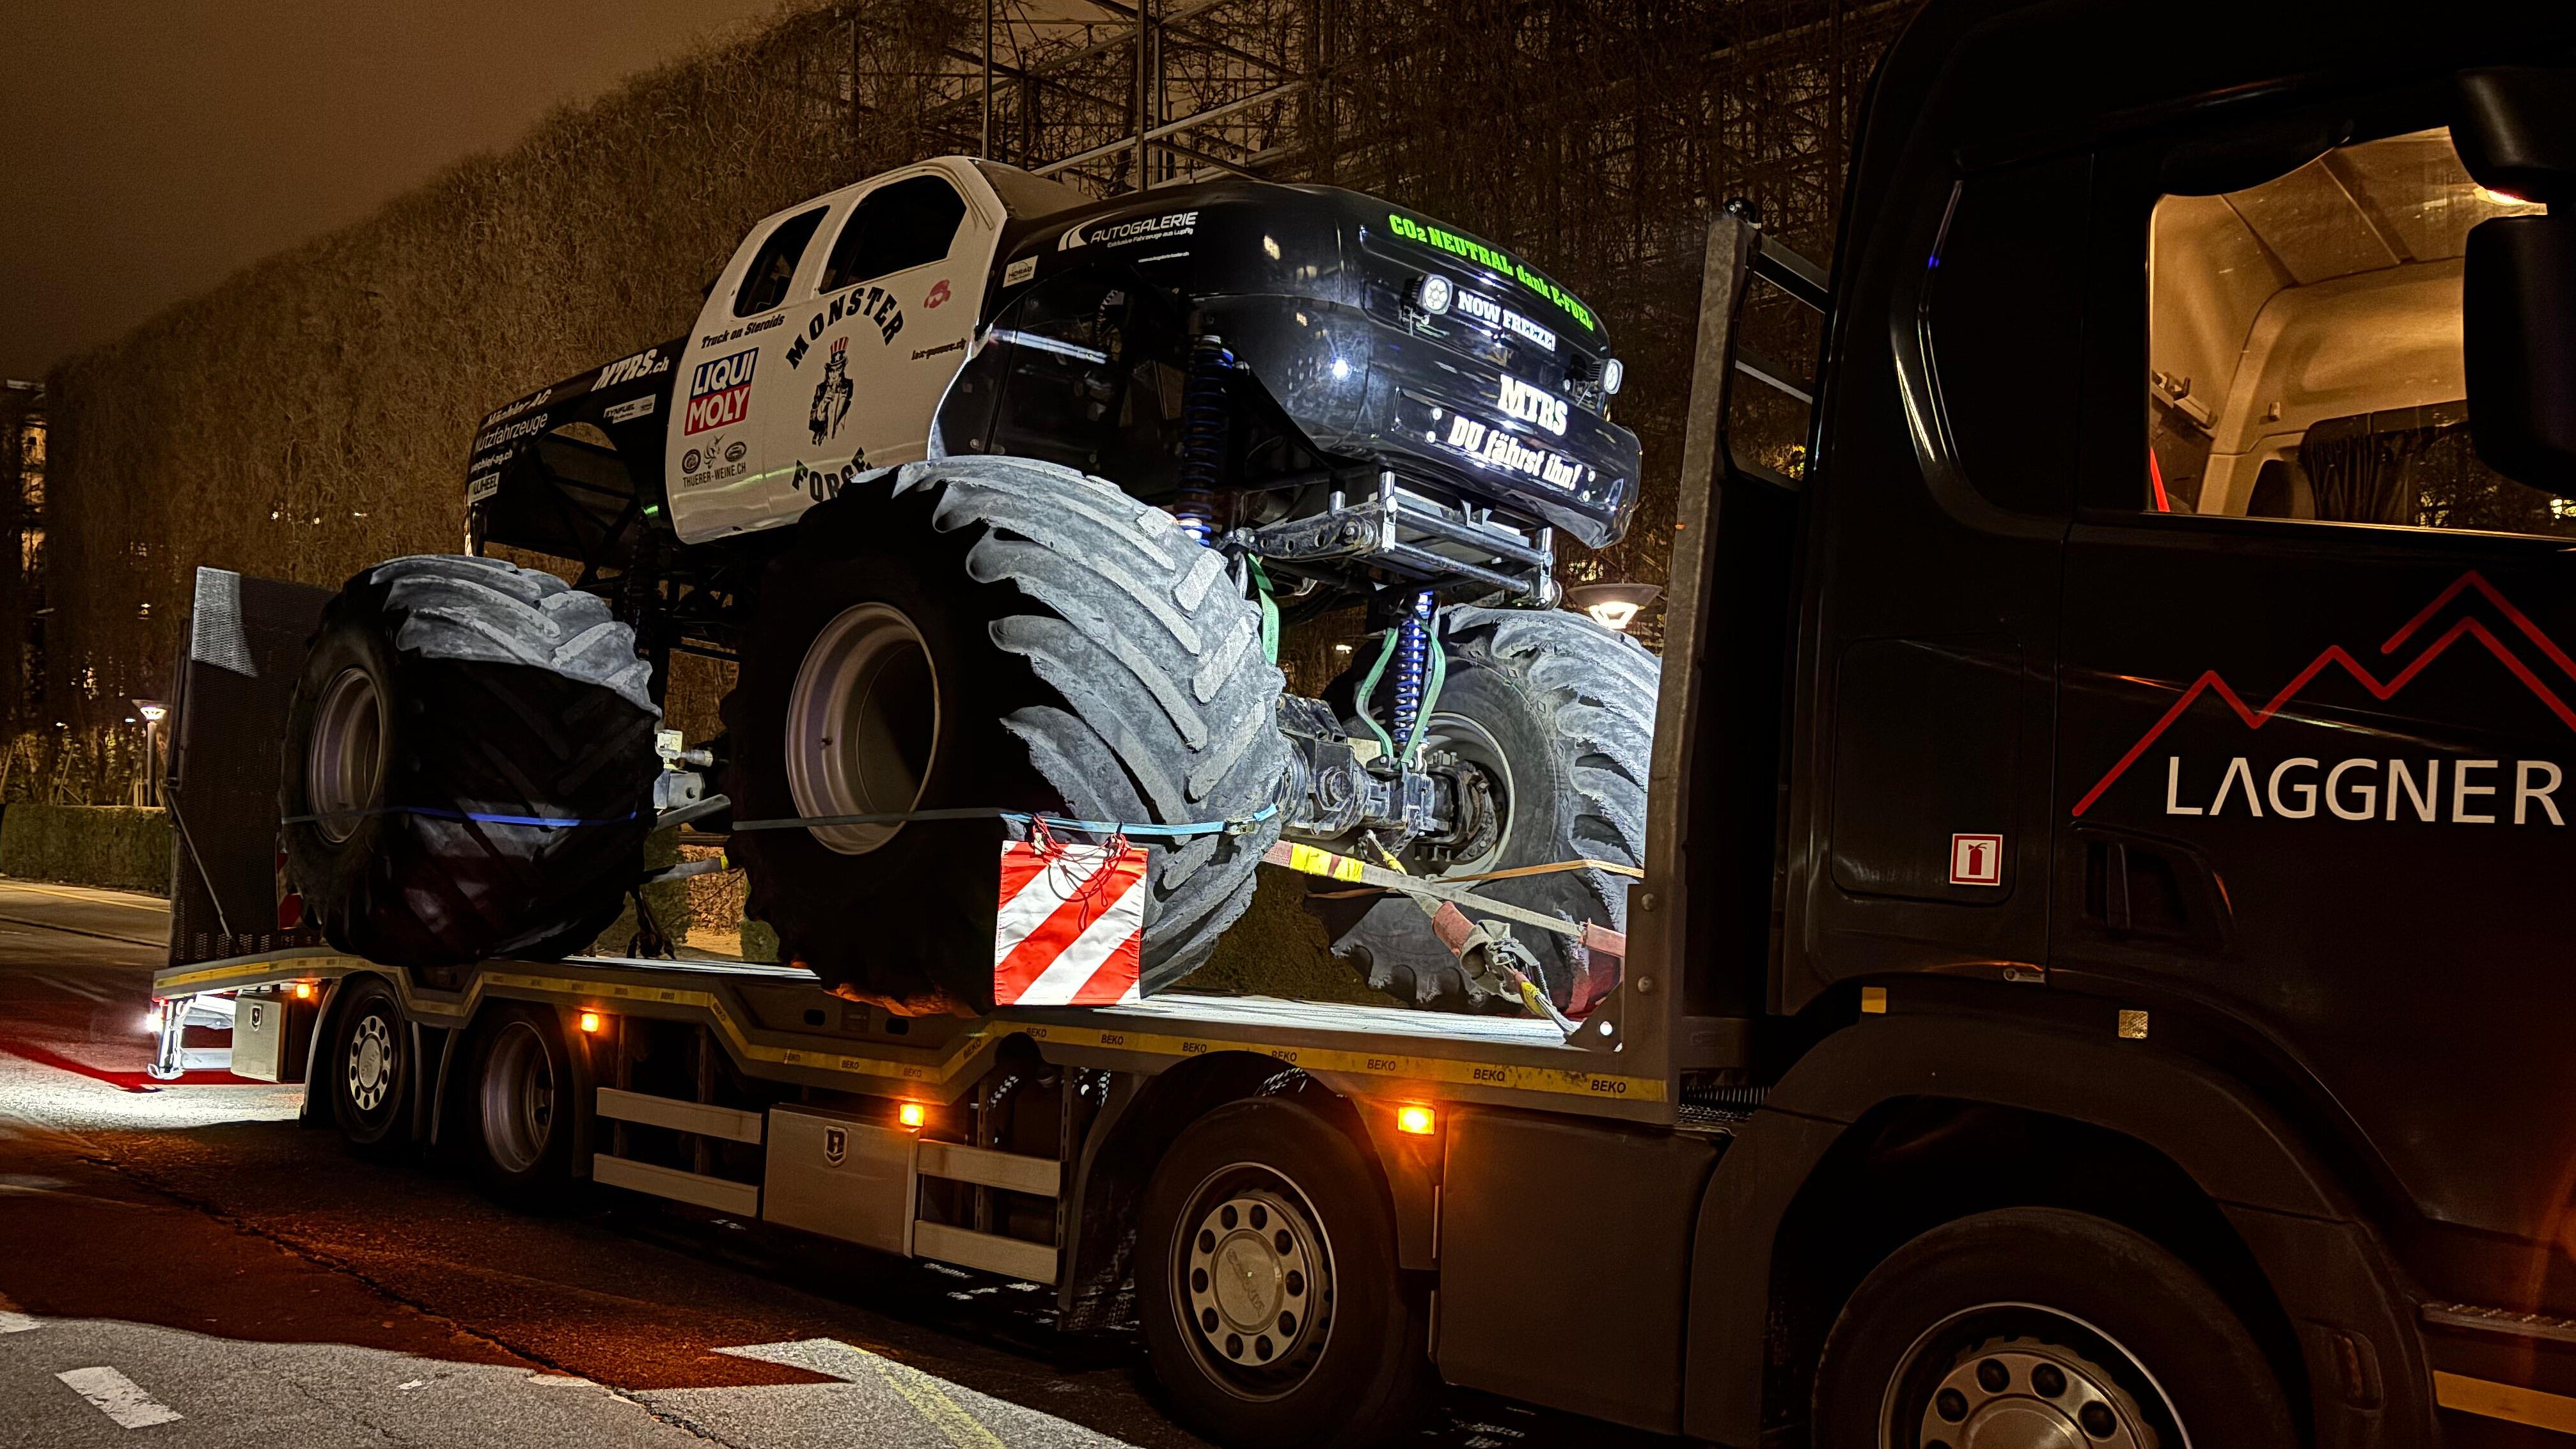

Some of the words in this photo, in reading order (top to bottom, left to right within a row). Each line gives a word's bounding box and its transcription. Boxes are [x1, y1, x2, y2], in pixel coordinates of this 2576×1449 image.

[1090, 212, 1198, 244] AUTOGALERIE
[1427, 226, 1514, 276] NEUTRAL
[1516, 263, 1550, 299] dank
[1551, 288, 1594, 331] E-FUEL
[701, 330, 730, 349] Truck
[730, 328, 743, 340] on
[744, 314, 785, 336] Steroids
[785, 286, 904, 370] MONSTER
[1457, 290, 1501, 327] NOW
[1502, 308, 1556, 352] FREEZE!
[590, 349, 670, 392] MTRS.ch
[693, 350, 756, 397] LIQUI
[687, 386, 751, 433] MOLY
[1497, 373, 1568, 436] MTRS
[1447, 415, 1486, 451] DU
[1484, 429, 1545, 476] fährst
[1542, 451, 1583, 491] ihn!
[682, 462, 746, 488] THUERER-WEINE.CH
[2166, 756, 2566, 826] LAGGNER
[963, 1037, 983, 1060] BEKO
[1025, 1027, 1048, 1038] BEKO
[1101, 1034, 1124, 1046] BEKO
[1182, 1042, 1207, 1054] BEKO
[841, 1060, 860, 1070] BEKO
[904, 1067, 922, 1078] BEKO
[1367, 1058, 1396, 1072] BEKO
[1473, 1068, 1506, 1083] BEKO
[1590, 1079, 1627, 1094] BEKO
